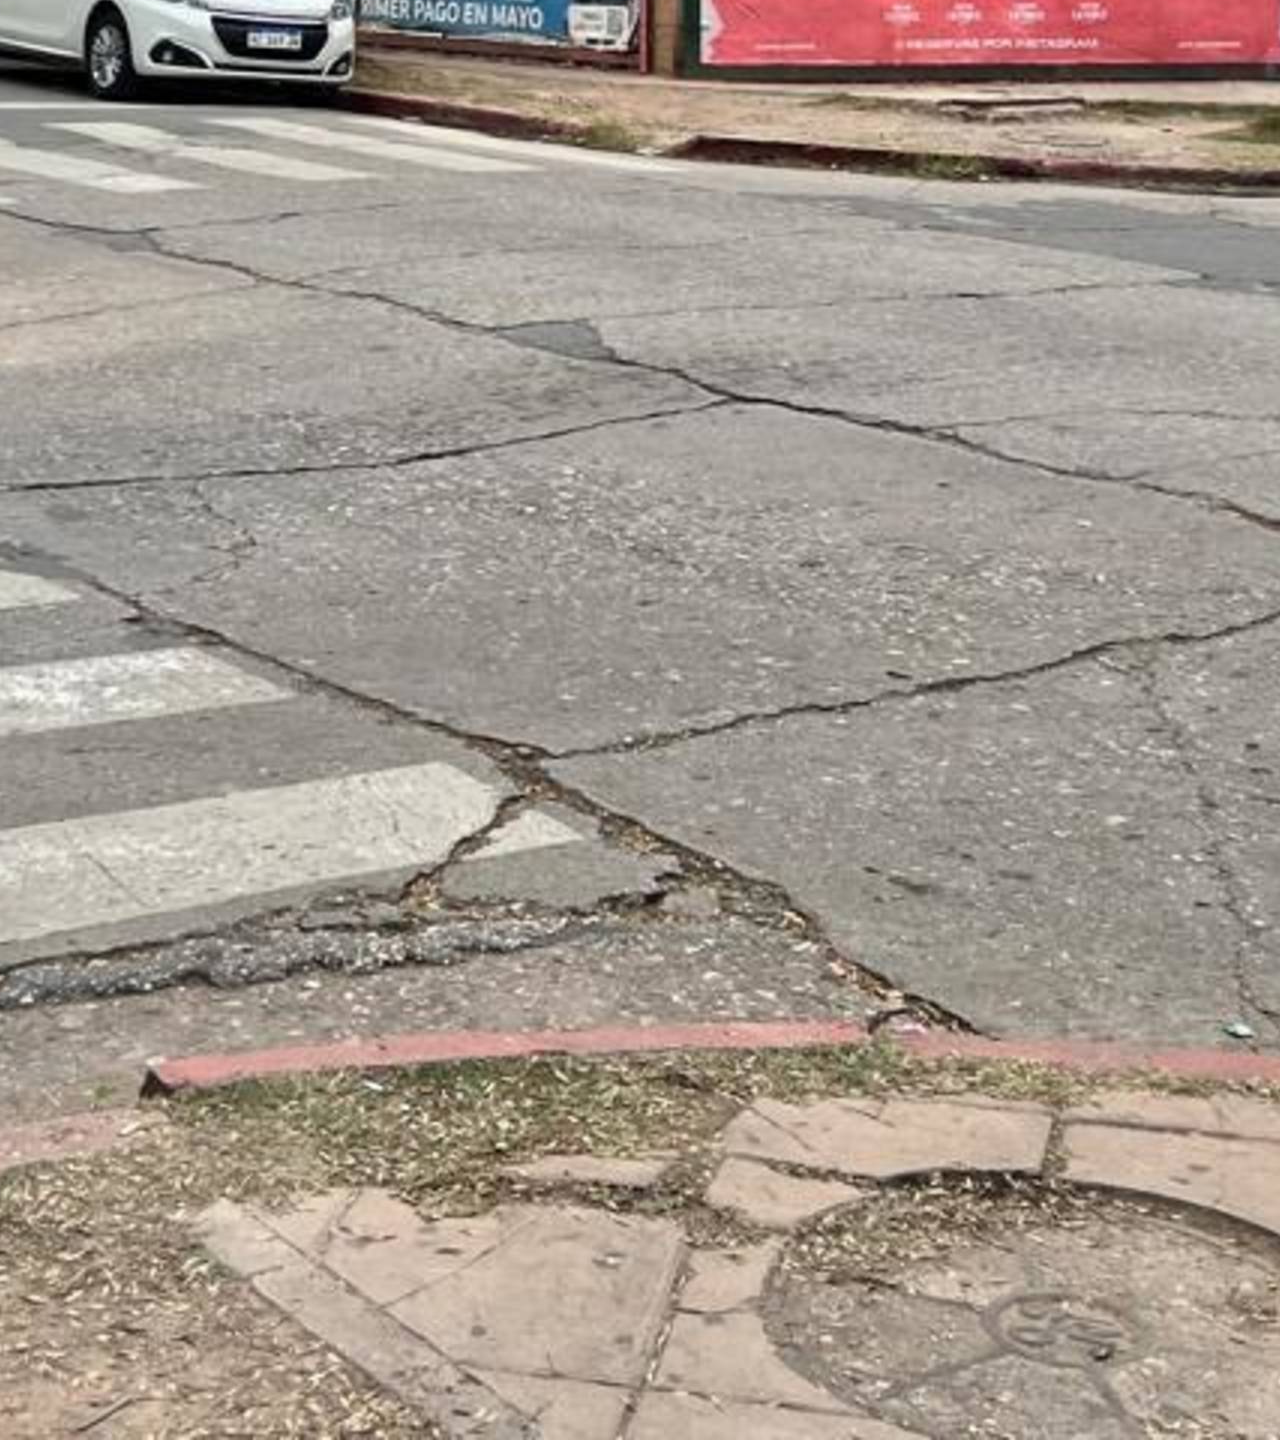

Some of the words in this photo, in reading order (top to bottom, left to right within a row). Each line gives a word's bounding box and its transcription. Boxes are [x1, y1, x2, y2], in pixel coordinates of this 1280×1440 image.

[414, 0, 458, 27] PAGO
[462, 3, 487, 26] EN
[492, 6, 544, 31] MAYO
